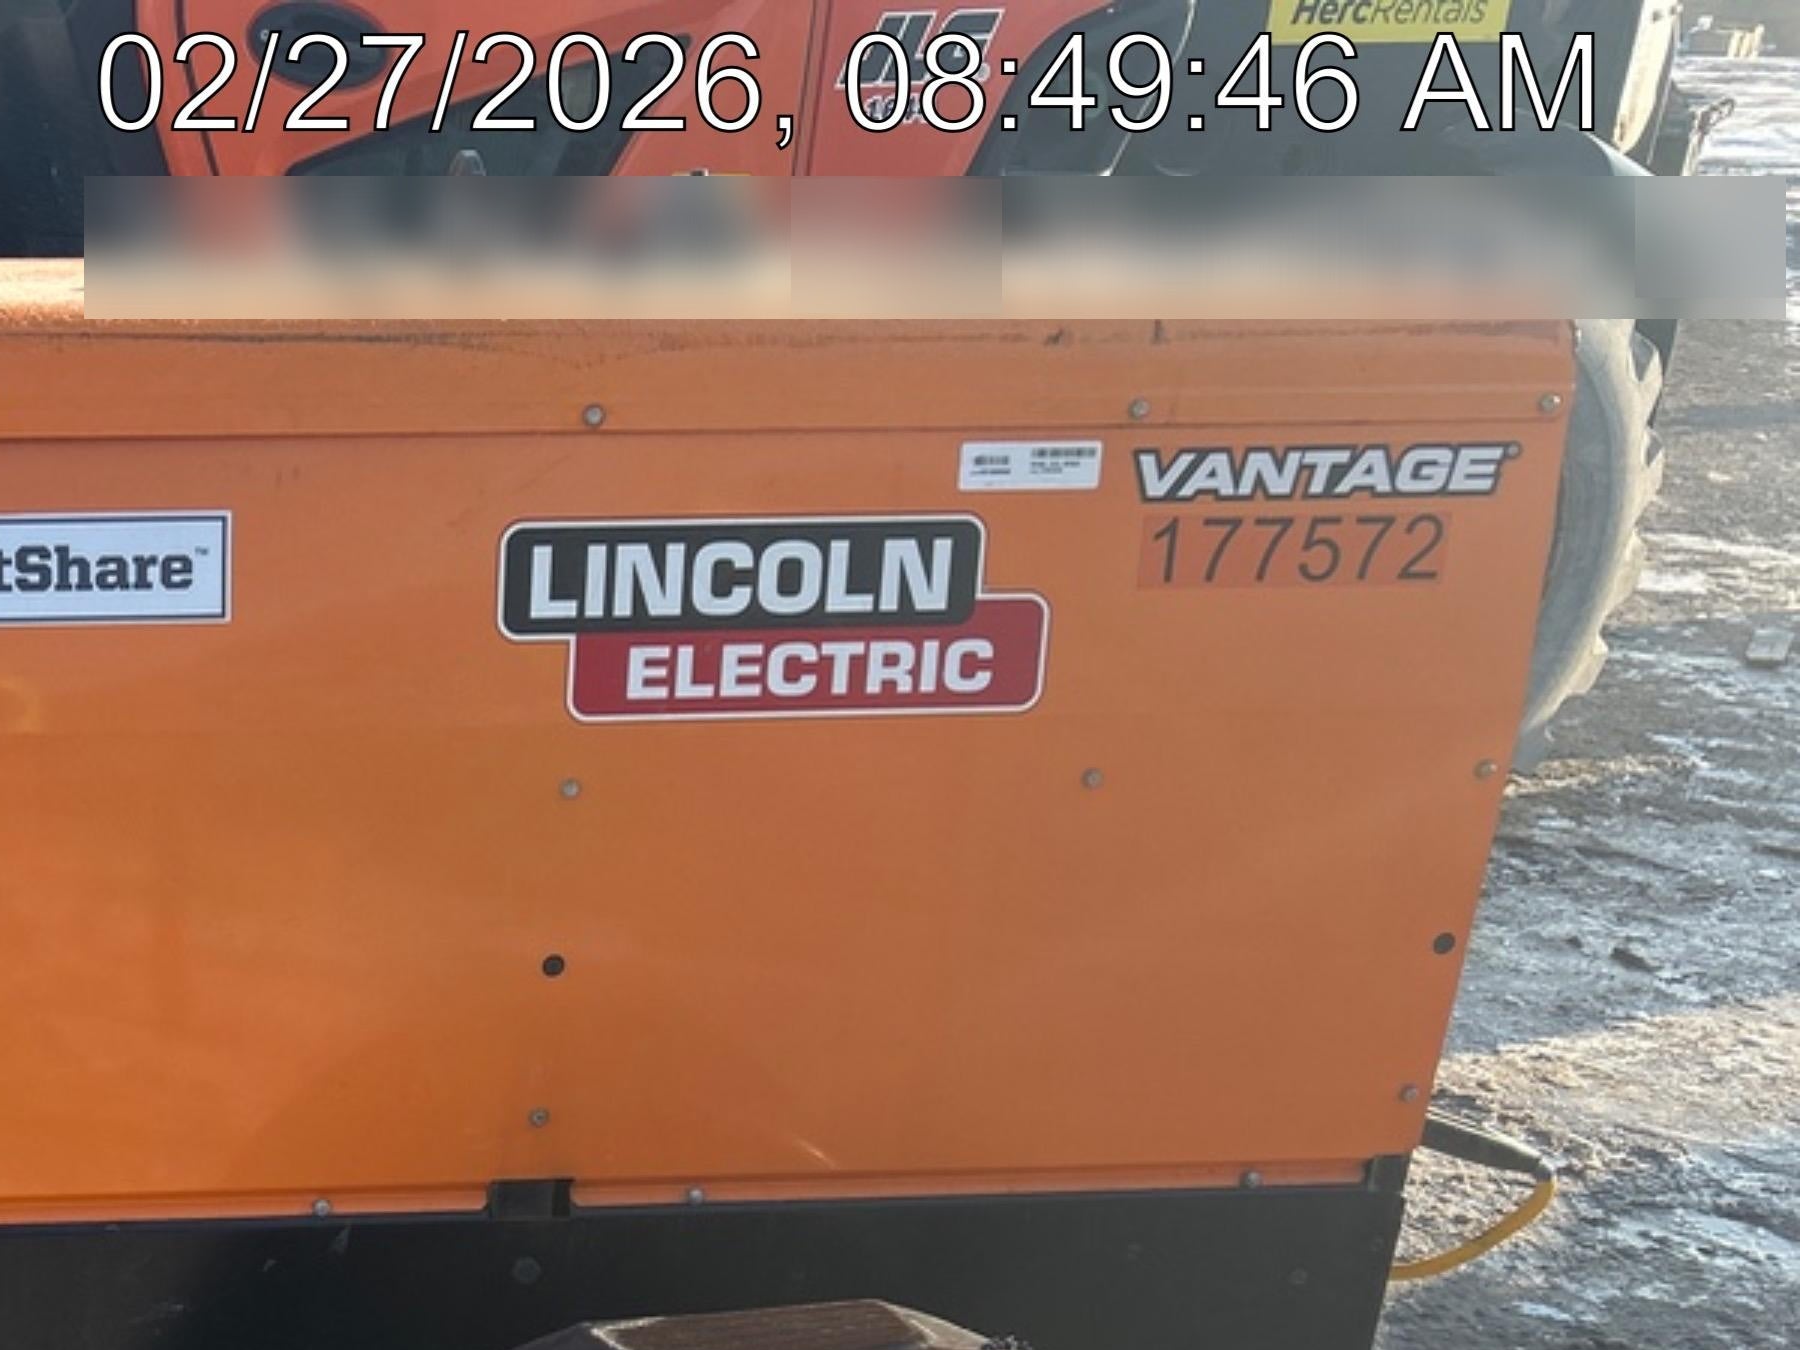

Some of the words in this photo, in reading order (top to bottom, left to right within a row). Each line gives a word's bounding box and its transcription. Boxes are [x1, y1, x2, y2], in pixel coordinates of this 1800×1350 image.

[1137, 445, 1505, 499] VANTAGE
[529, 537, 953, 619] LINCOLN
[1153, 512, 1445, 583] 177572
[625, 638, 995, 699] ELECTRIC
